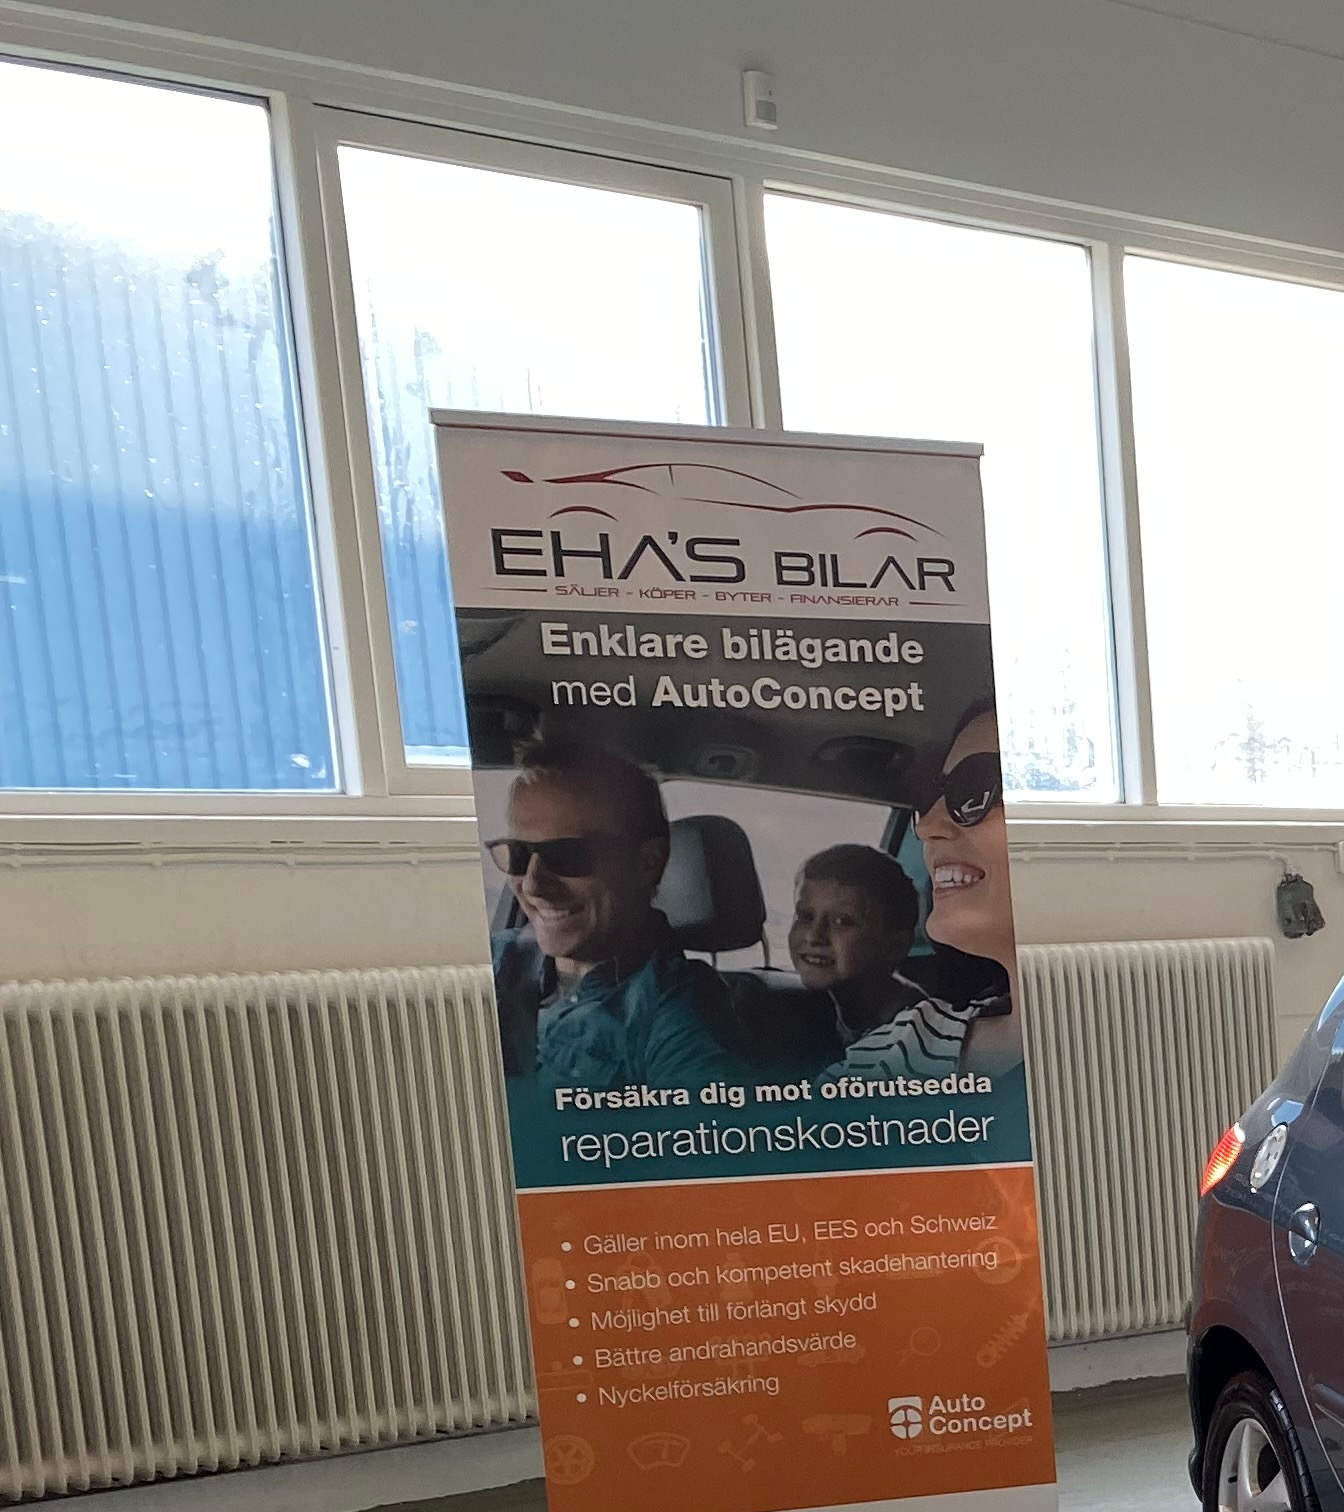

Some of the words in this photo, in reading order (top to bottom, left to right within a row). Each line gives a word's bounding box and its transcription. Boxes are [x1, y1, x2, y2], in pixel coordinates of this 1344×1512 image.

[492, 528, 746, 583] EHA'S
[774, 552, 956, 592] BILAR
[555, 584, 619, 598] SÄLJER
[639, 588, 696, 600] KÖPER
[715, 591, 772, 603] BYTER
[790, 594, 899, 607] FINANSIERAR
[541, 622, 708, 659] Enklare
[721, 627, 924, 669] bilägande
[552, 675, 637, 707] med
[652, 675, 925, 717] AutoConcept
[555, 1085, 690, 1111] Försäkra
[700, 1082, 746, 1108] dig
[755, 1080, 812, 1102] mot
[821, 1073, 992, 1100] oförutsedda
[561, 1109, 995, 1169] reparationskostnader
[584, 1234, 648, 1255] Gäller
[655, 1231, 709, 1250] inom
[717, 1229, 762, 1246] hela
[768, 1224, 806, 1245] EU,
[814, 1219, 858, 1241] EES
[864, 1217, 903, 1237] och
[910, 1212, 998, 1235] Schweiz
[587, 1269, 661, 1293] Snabb
[668, 1267, 709, 1287] och
[716, 1259, 832, 1284] kompetent
[839, 1249, 998, 1276] skadehantering
[591, 1306, 691, 1332] Möjlighet
[698, 1303, 719, 1321] till
[726, 1297, 807, 1321] förlängt
[814, 1292, 877, 1317] skydd
[595, 1347, 662, 1369] Bättre
[669, 1330, 857, 1363] andrahandsvärde
[598, 1374, 780, 1409] Nyckelförsäkring
[928, 1393, 986, 1416] Auto
[929, 1408, 1033, 1435] Concept
